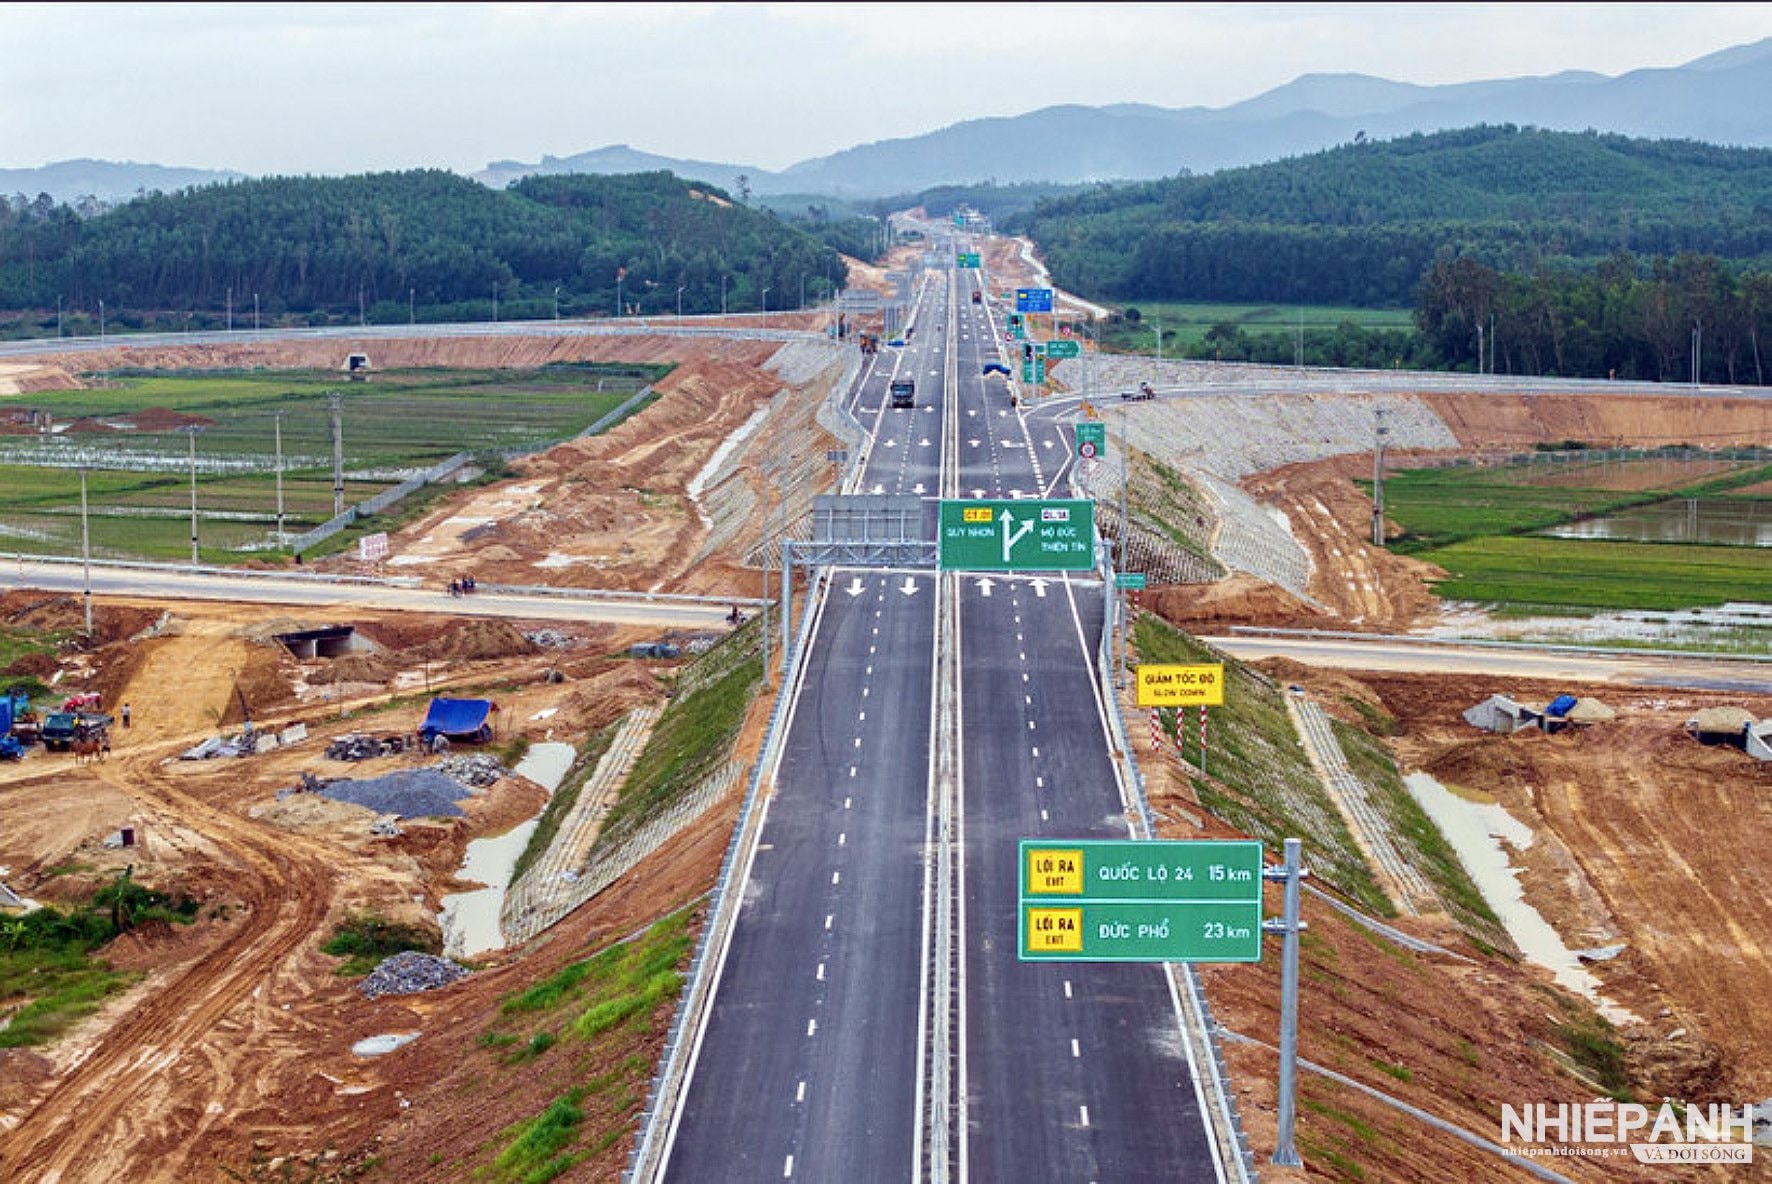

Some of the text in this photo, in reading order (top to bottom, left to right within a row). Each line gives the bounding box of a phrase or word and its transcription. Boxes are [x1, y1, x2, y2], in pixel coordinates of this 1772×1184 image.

[1145, 669, 1215, 685] GIẢM TỐC ĐỘ
[1153, 688, 1206, 697] SLOW DOWN
[1058, 859, 1075, 873] RA
[1099, 860, 1252, 884] QUỐC LỘ 24 15 km
[1045, 876, 1065, 887] EXIT
[1058, 917, 1075, 931] RA
[1099, 917, 1250, 939] ĐỨC PHỔ 23 km
[1045, 935, 1064, 945] EXIT
